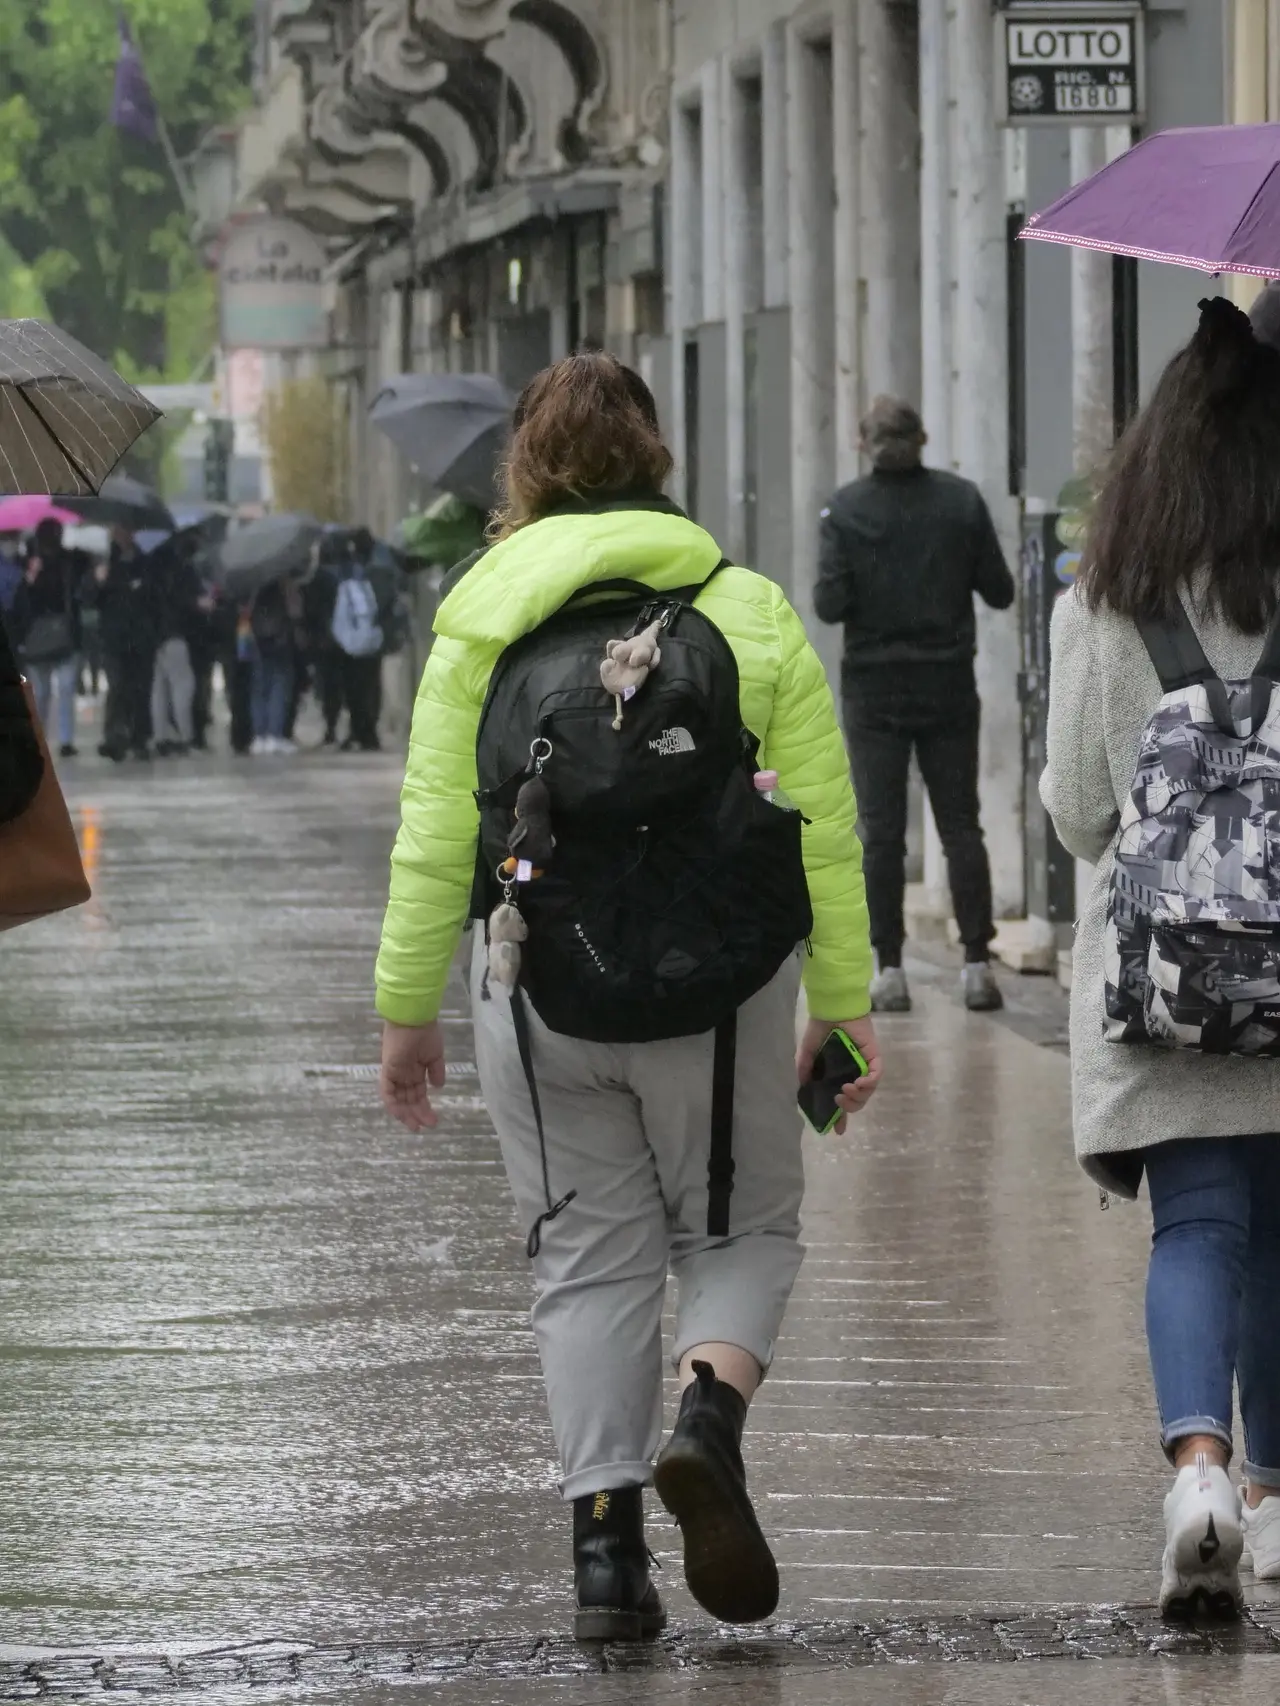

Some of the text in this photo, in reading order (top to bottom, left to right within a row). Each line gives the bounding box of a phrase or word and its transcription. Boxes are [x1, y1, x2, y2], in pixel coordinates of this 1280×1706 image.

[1016, 30, 1122, 58] LOTTO
[1059, 86, 1117, 107] 1680
[648, 735, 679, 750] NORTH
[662, 728, 678, 738] THE
[659, 744, 680, 756] FACE
[574, 923, 606, 973] BOREALIS
[592, 1491, 610, 1521] irWair
